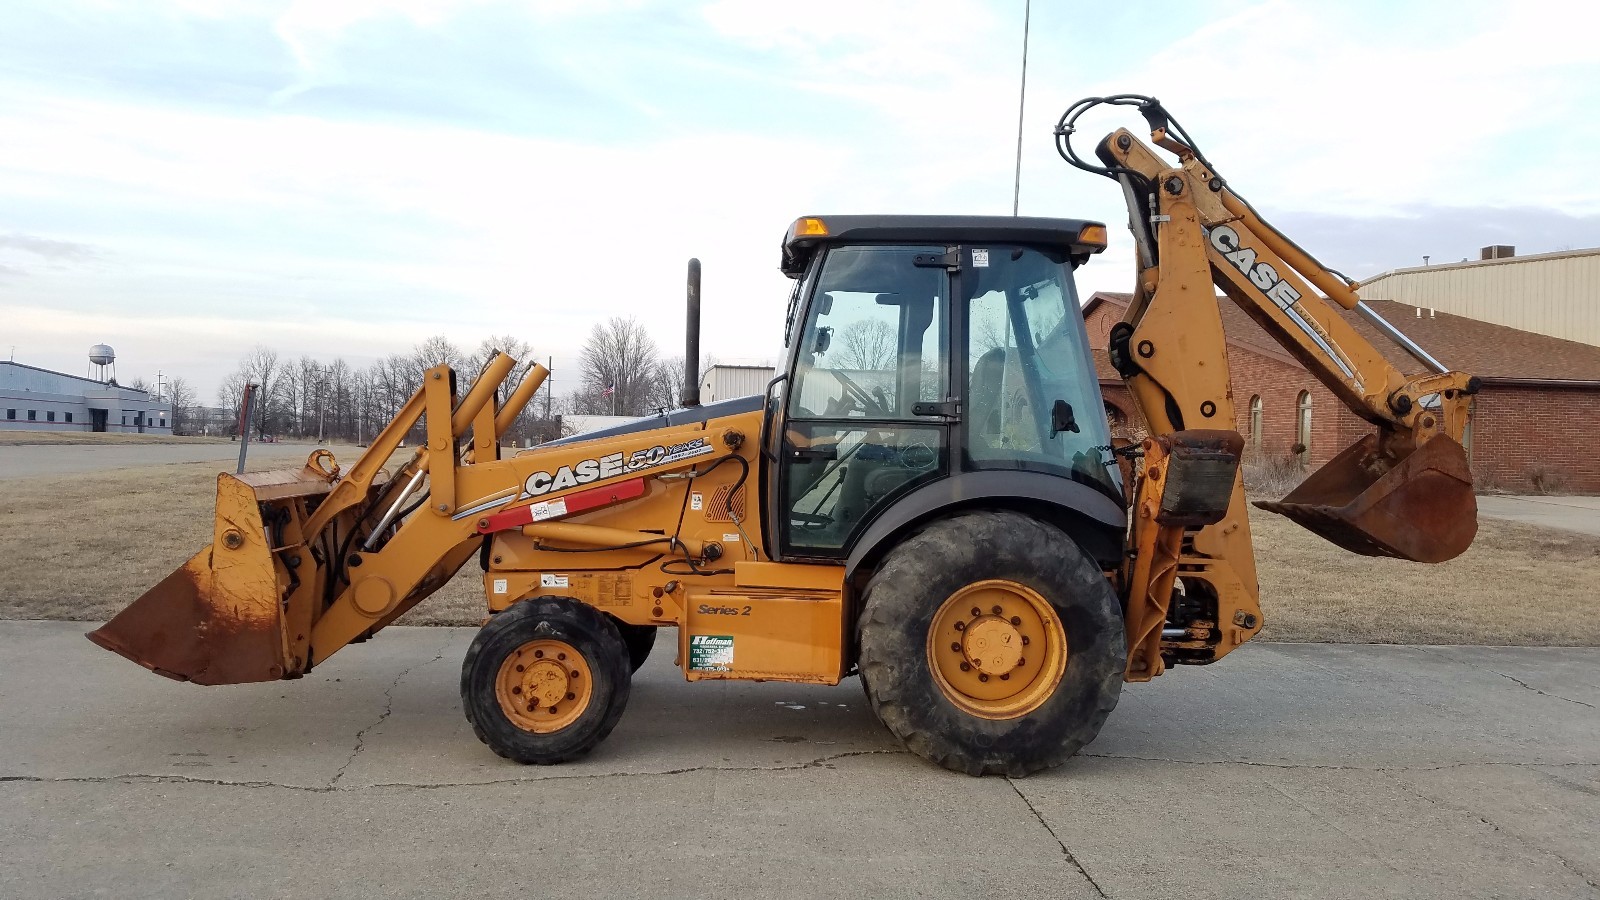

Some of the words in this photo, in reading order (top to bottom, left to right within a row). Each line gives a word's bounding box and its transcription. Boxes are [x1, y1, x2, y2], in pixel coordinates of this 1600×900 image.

[1210, 225, 1302, 310] CASE
[525, 452, 624, 496] CASE
[628, 446, 666, 469] 50
[668, 439, 704, 455] YEARS
[697, 604, 739, 616] Series
[741, 605, 752, 616] 2
[692, 635, 733, 646] Hoffman
